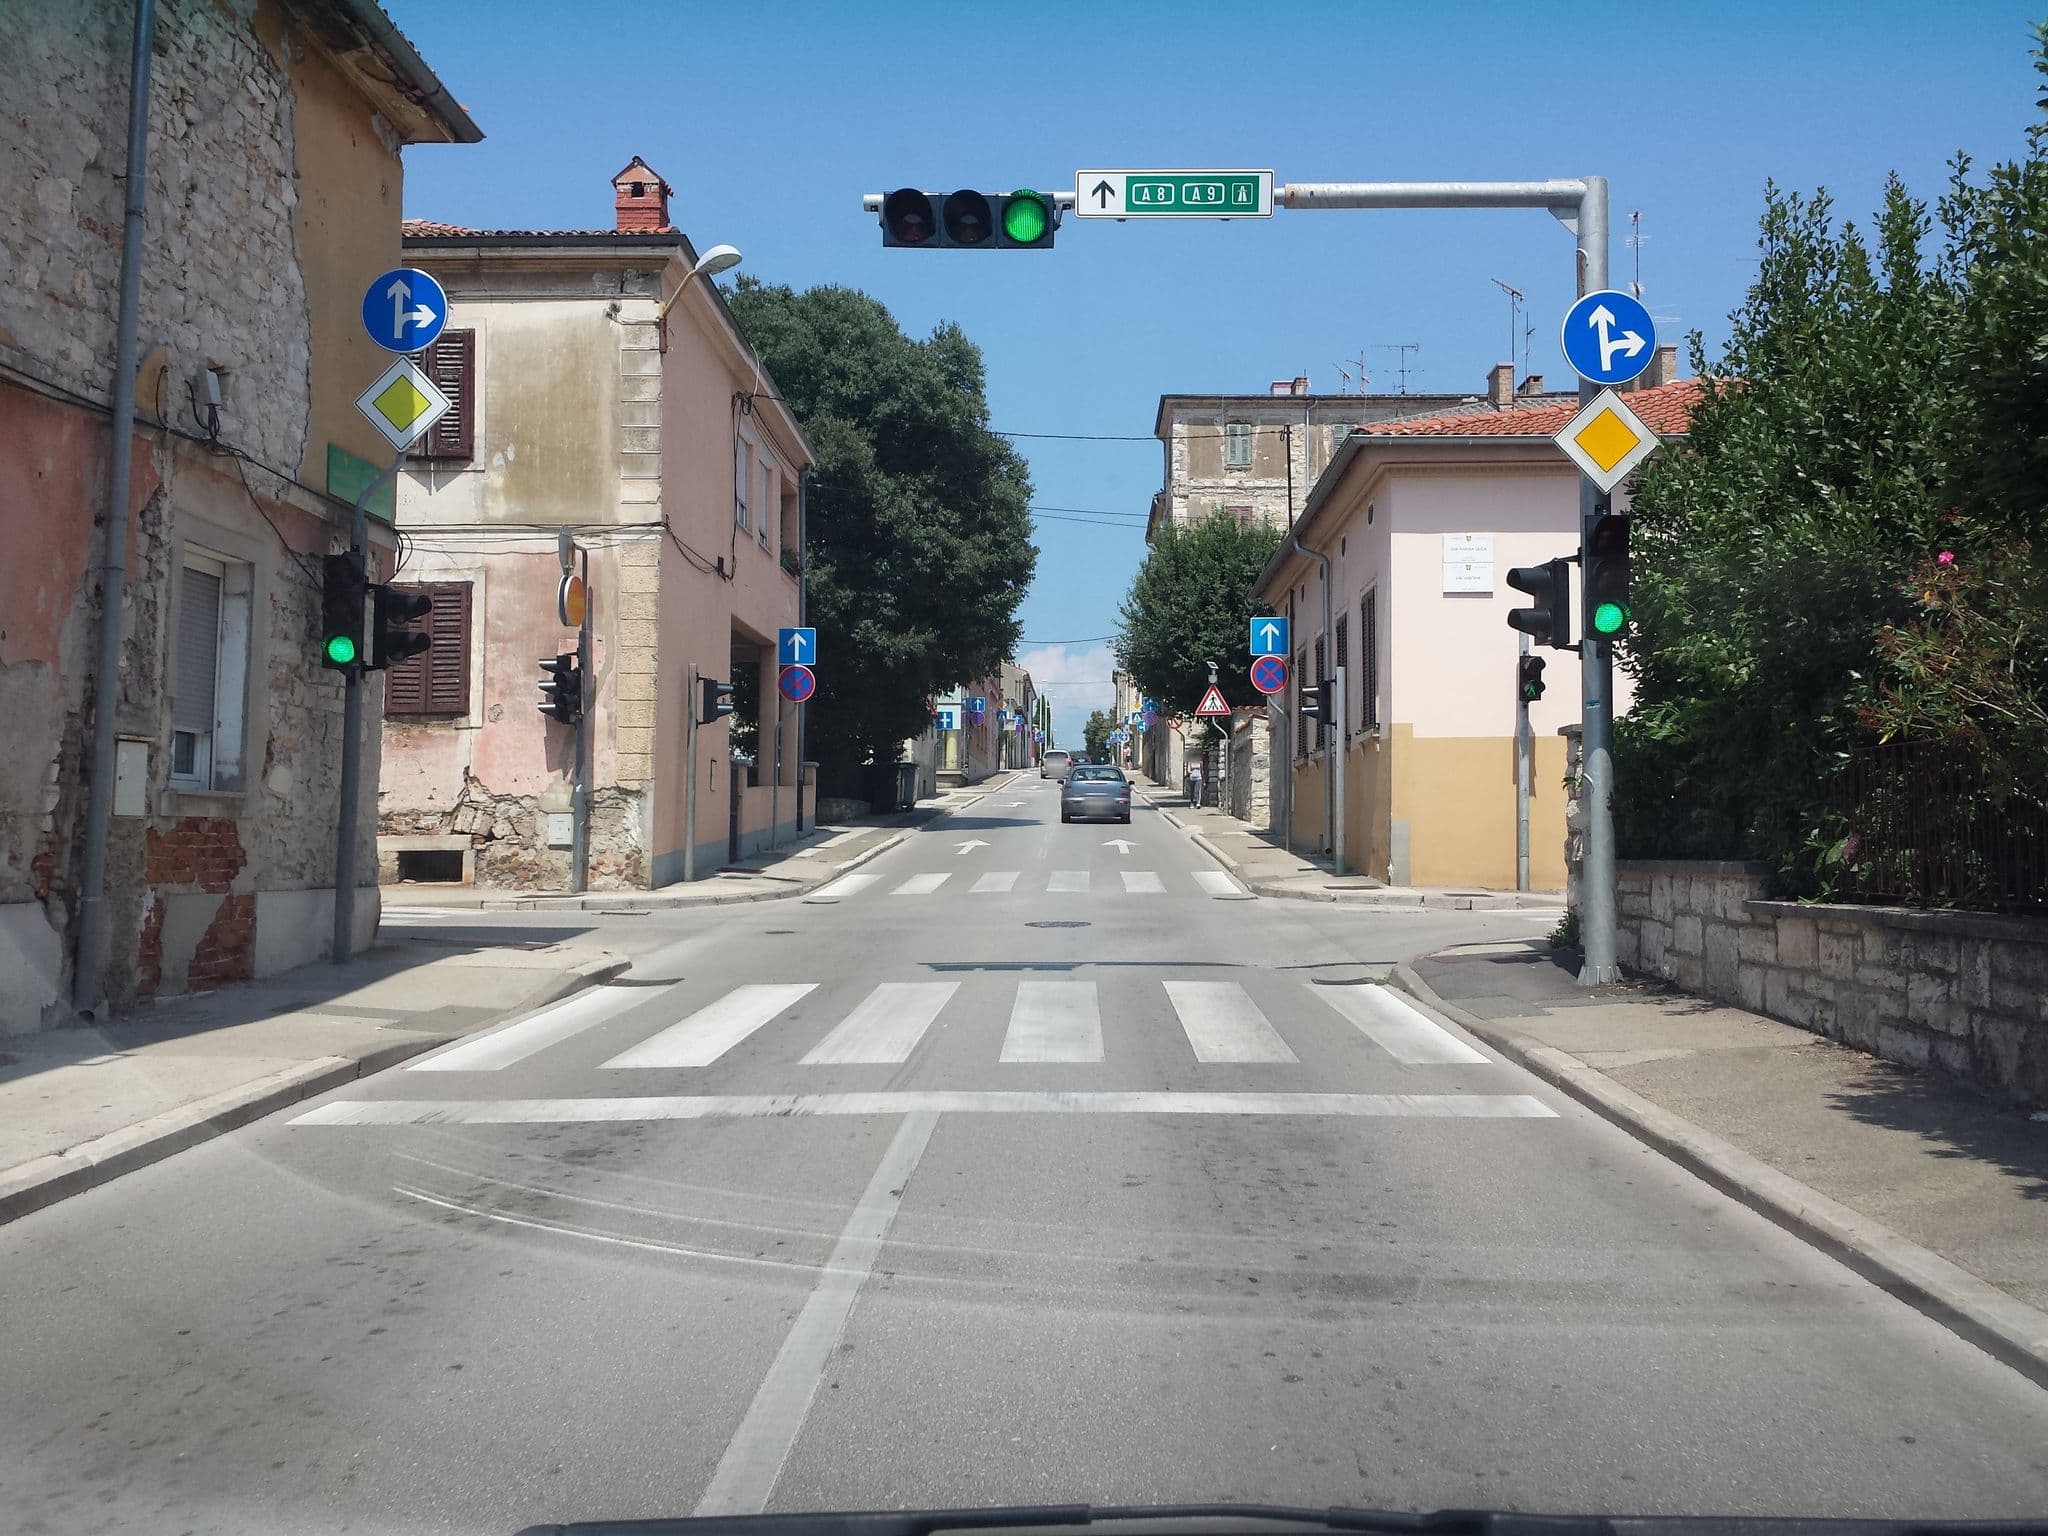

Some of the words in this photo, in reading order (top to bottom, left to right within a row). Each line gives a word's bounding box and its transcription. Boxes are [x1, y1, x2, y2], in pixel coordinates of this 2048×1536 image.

[1142, 187, 1151, 201] A
[1157, 187, 1165, 201] 8
[1192, 187, 1201, 201] A
[1207, 186, 1215, 201] 9
